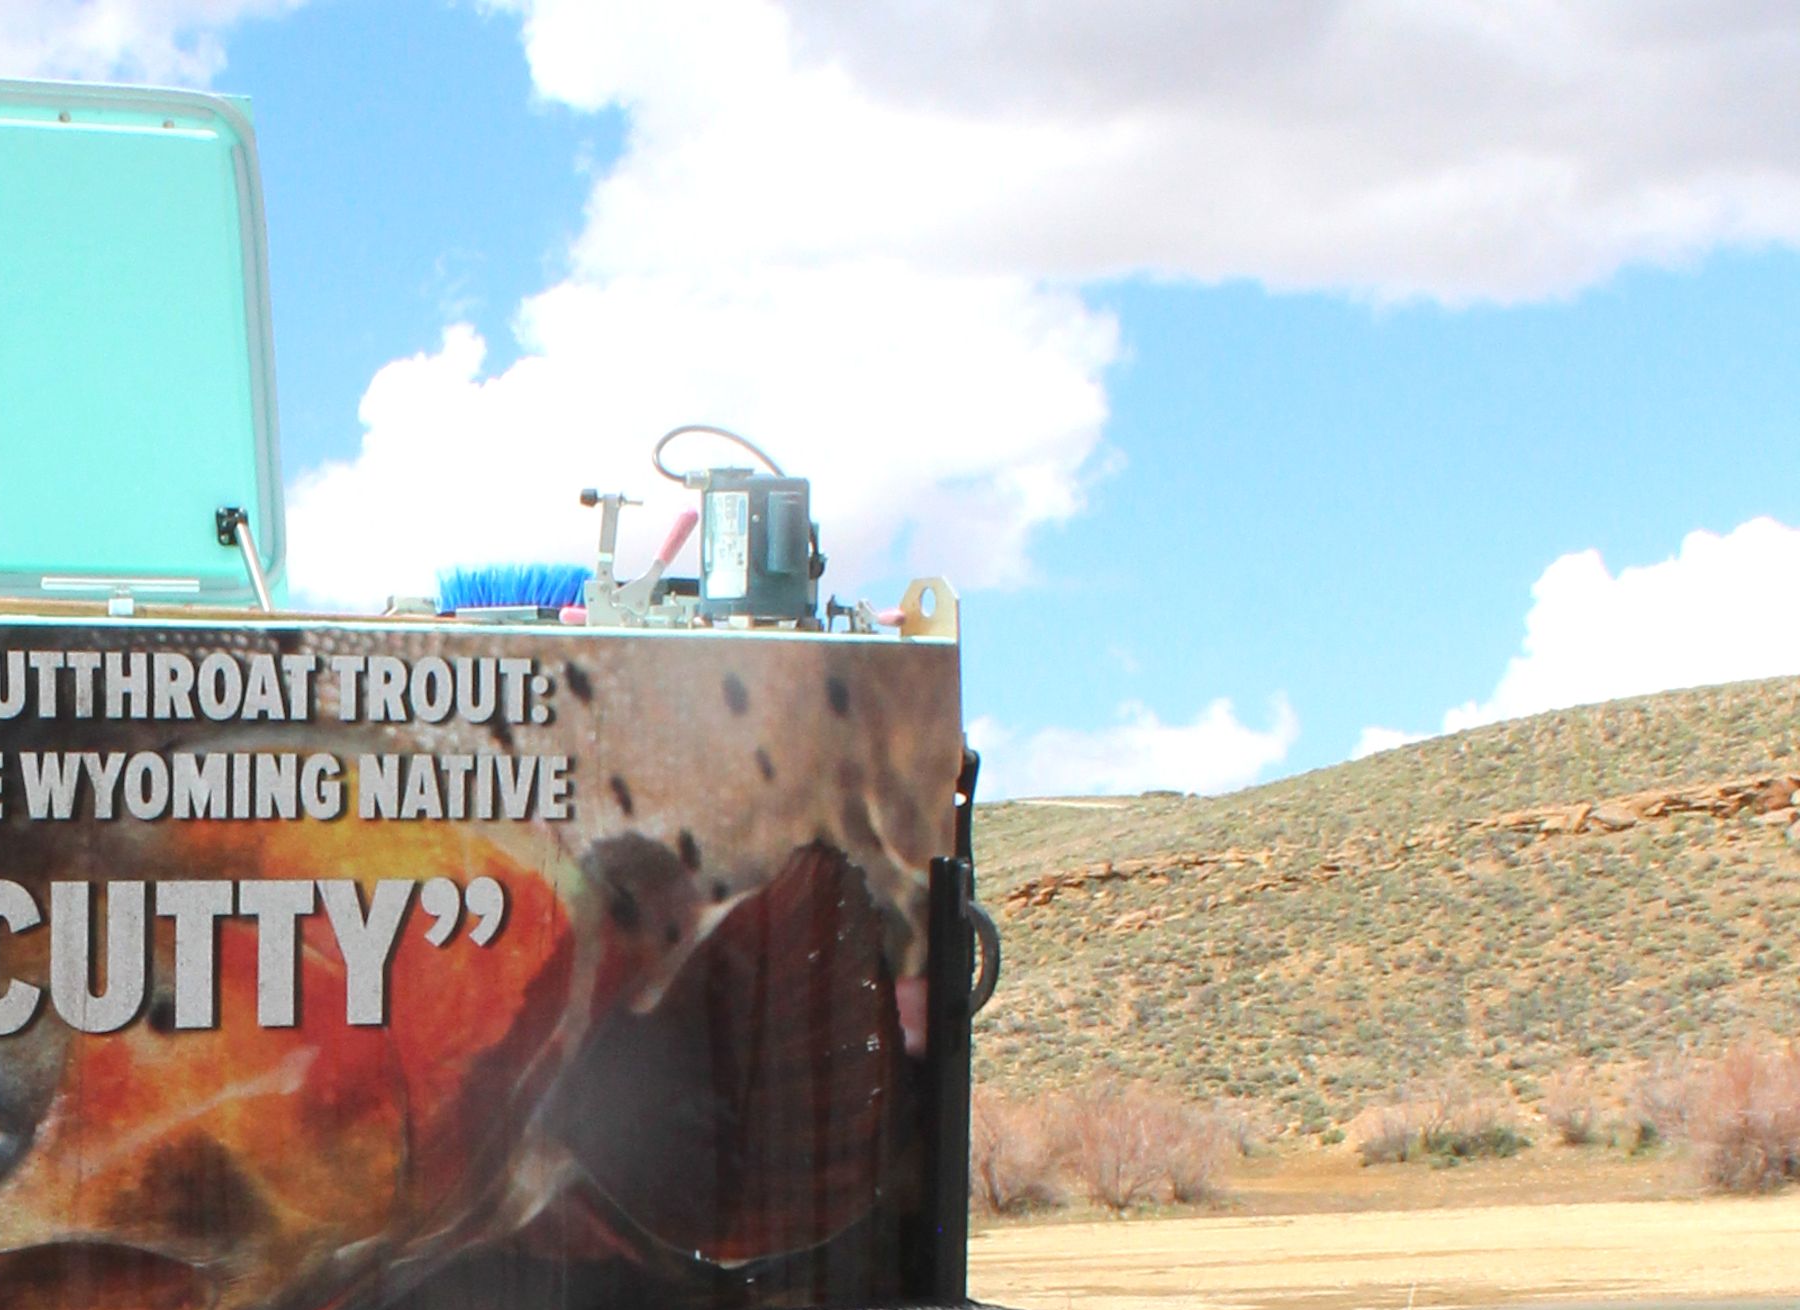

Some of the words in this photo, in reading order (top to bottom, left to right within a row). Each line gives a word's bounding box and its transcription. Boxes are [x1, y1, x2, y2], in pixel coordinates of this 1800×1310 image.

[331, 655, 551, 723] TROUT:
[19, 750, 343, 820] WYOMING
[358, 752, 568, 820] NATIVE
